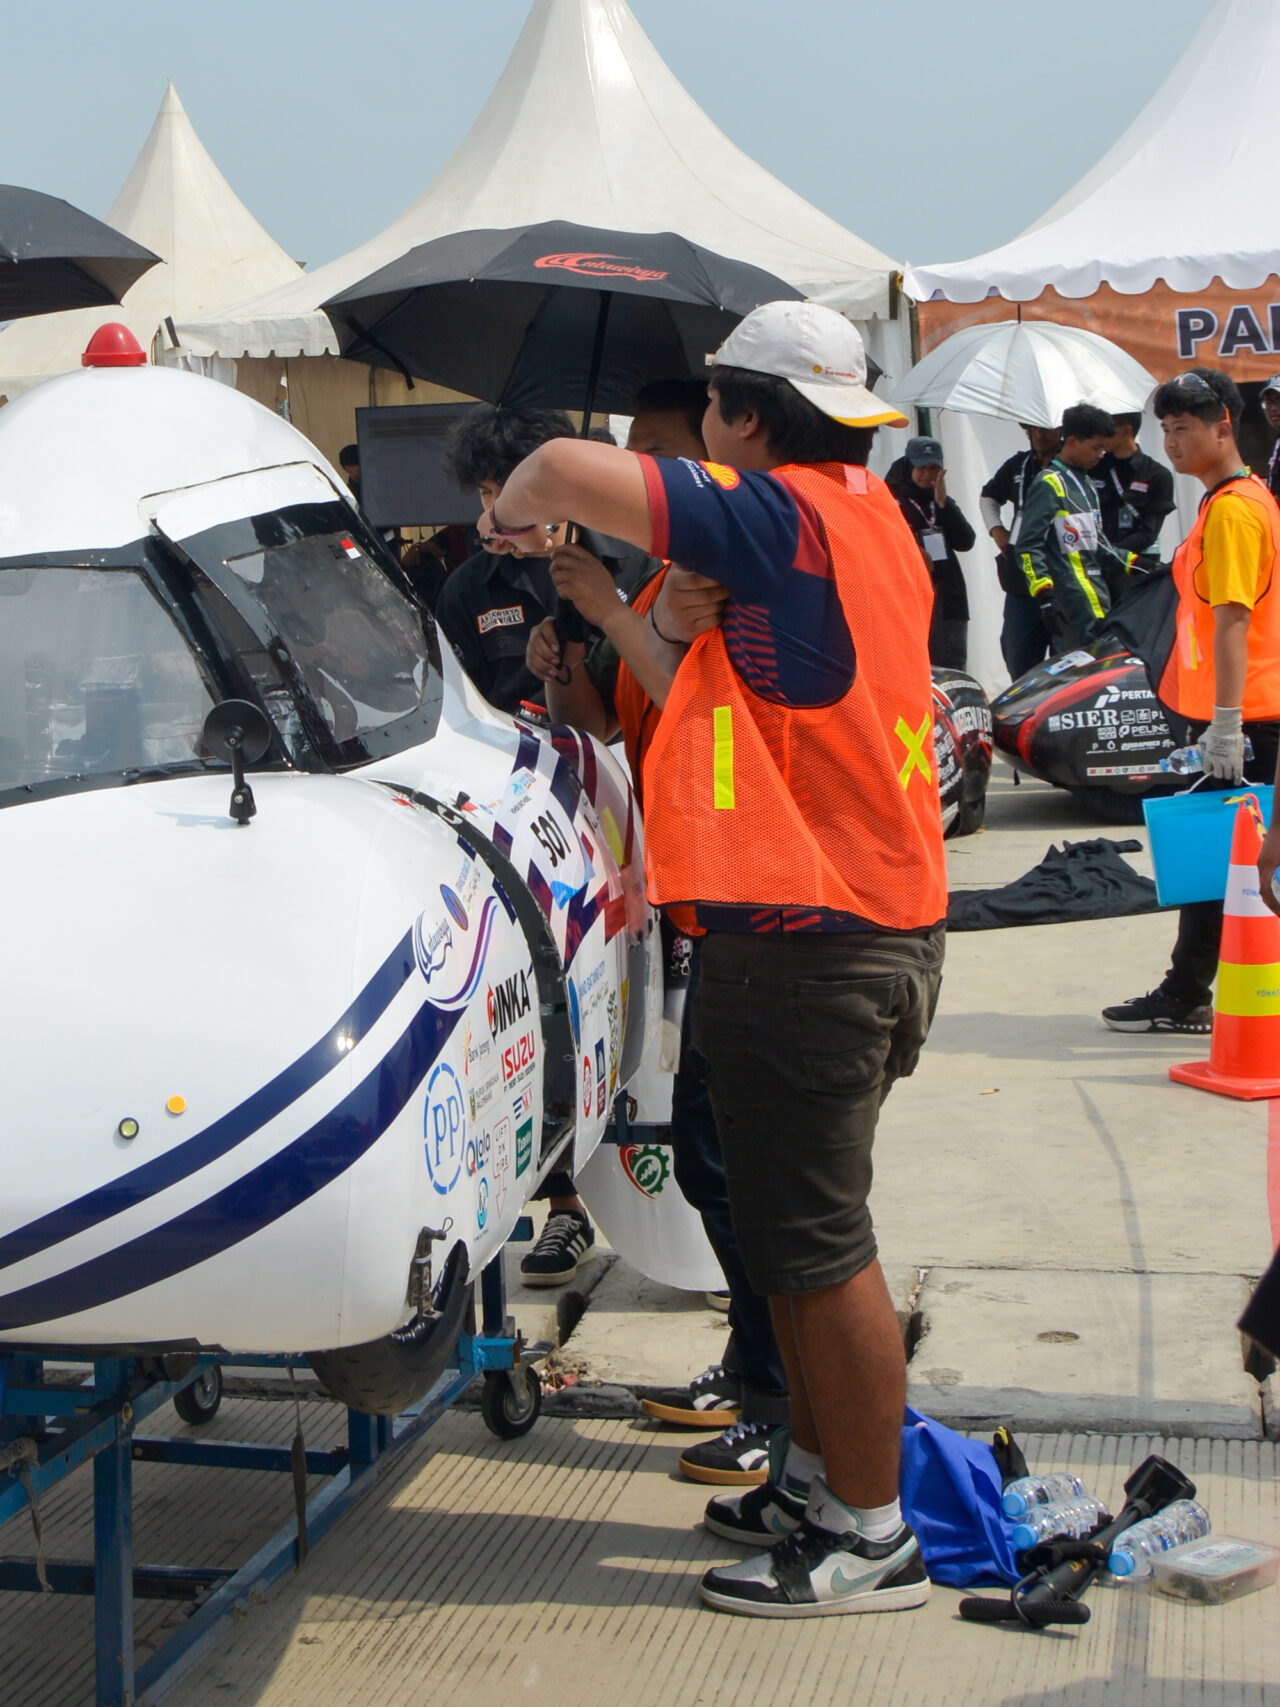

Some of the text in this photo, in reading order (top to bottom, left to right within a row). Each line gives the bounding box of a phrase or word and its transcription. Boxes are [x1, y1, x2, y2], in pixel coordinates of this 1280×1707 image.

[480, 607, 520, 625] ANTAWIRYA
[1121, 689, 1157, 700] PERTA
[1061, 708, 1120, 731] SIER
[1151, 710, 1166, 720] PL
[530, 809, 572, 868] 501
[501, 1029, 535, 1083] ISUZU
[495, 1124, 507, 1142] LIFT
[498, 1143, 506, 1156] ON
[496, 1155, 508, 1173] TIRE
